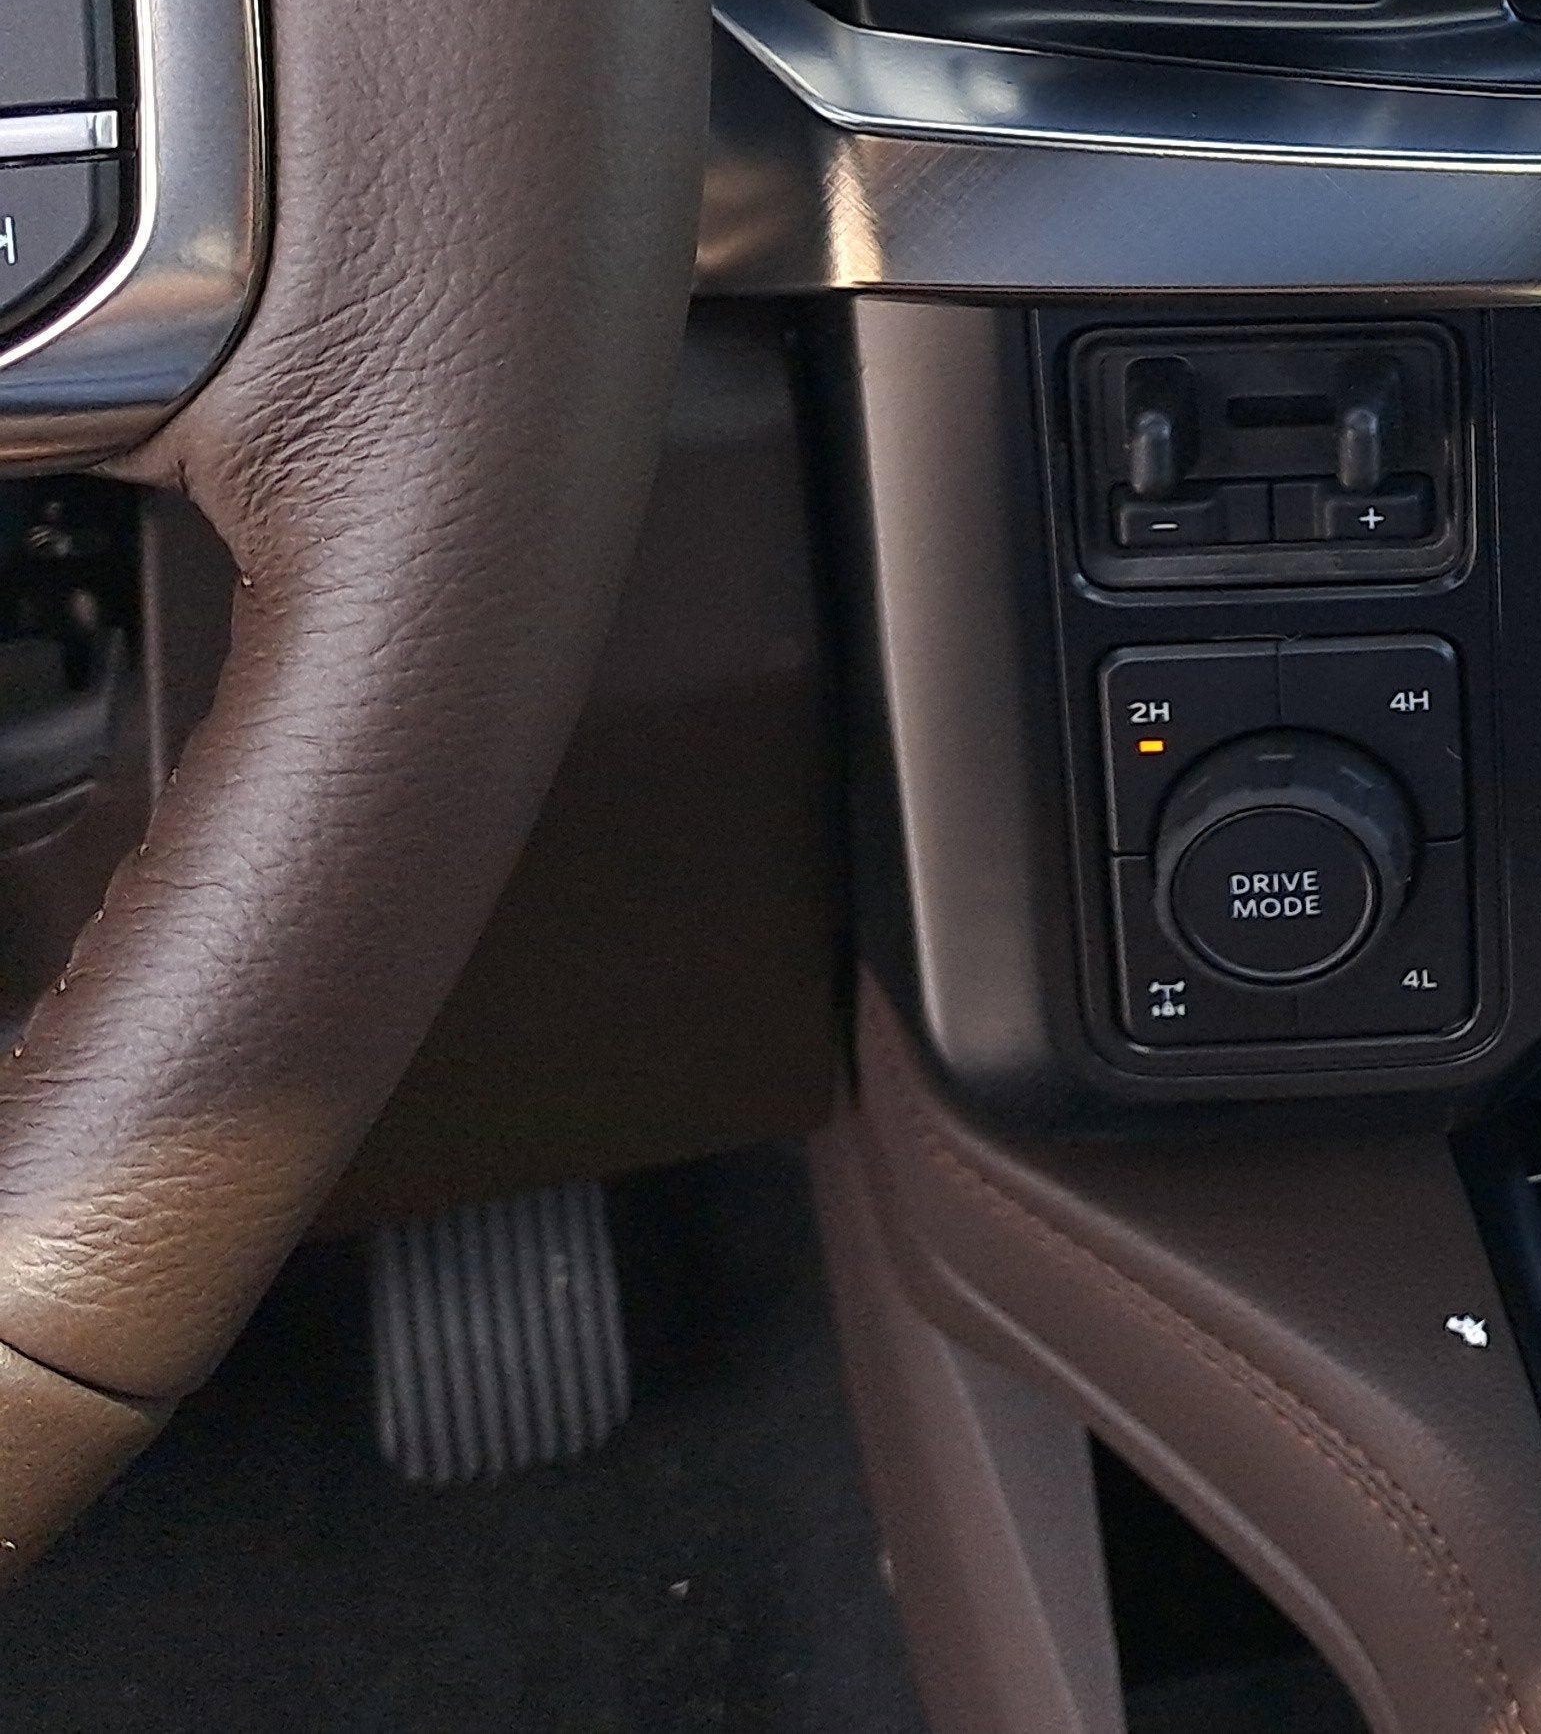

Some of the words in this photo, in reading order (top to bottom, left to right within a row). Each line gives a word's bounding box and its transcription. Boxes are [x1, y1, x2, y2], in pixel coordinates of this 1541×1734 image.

[1128, 700, 1171, 724] 2H
[1389, 690, 1431, 713] 4H
[1230, 870, 1319, 896] DRIVE
[1231, 894, 1322, 919] MODE
[1401, 968, 1437, 990] 4L
